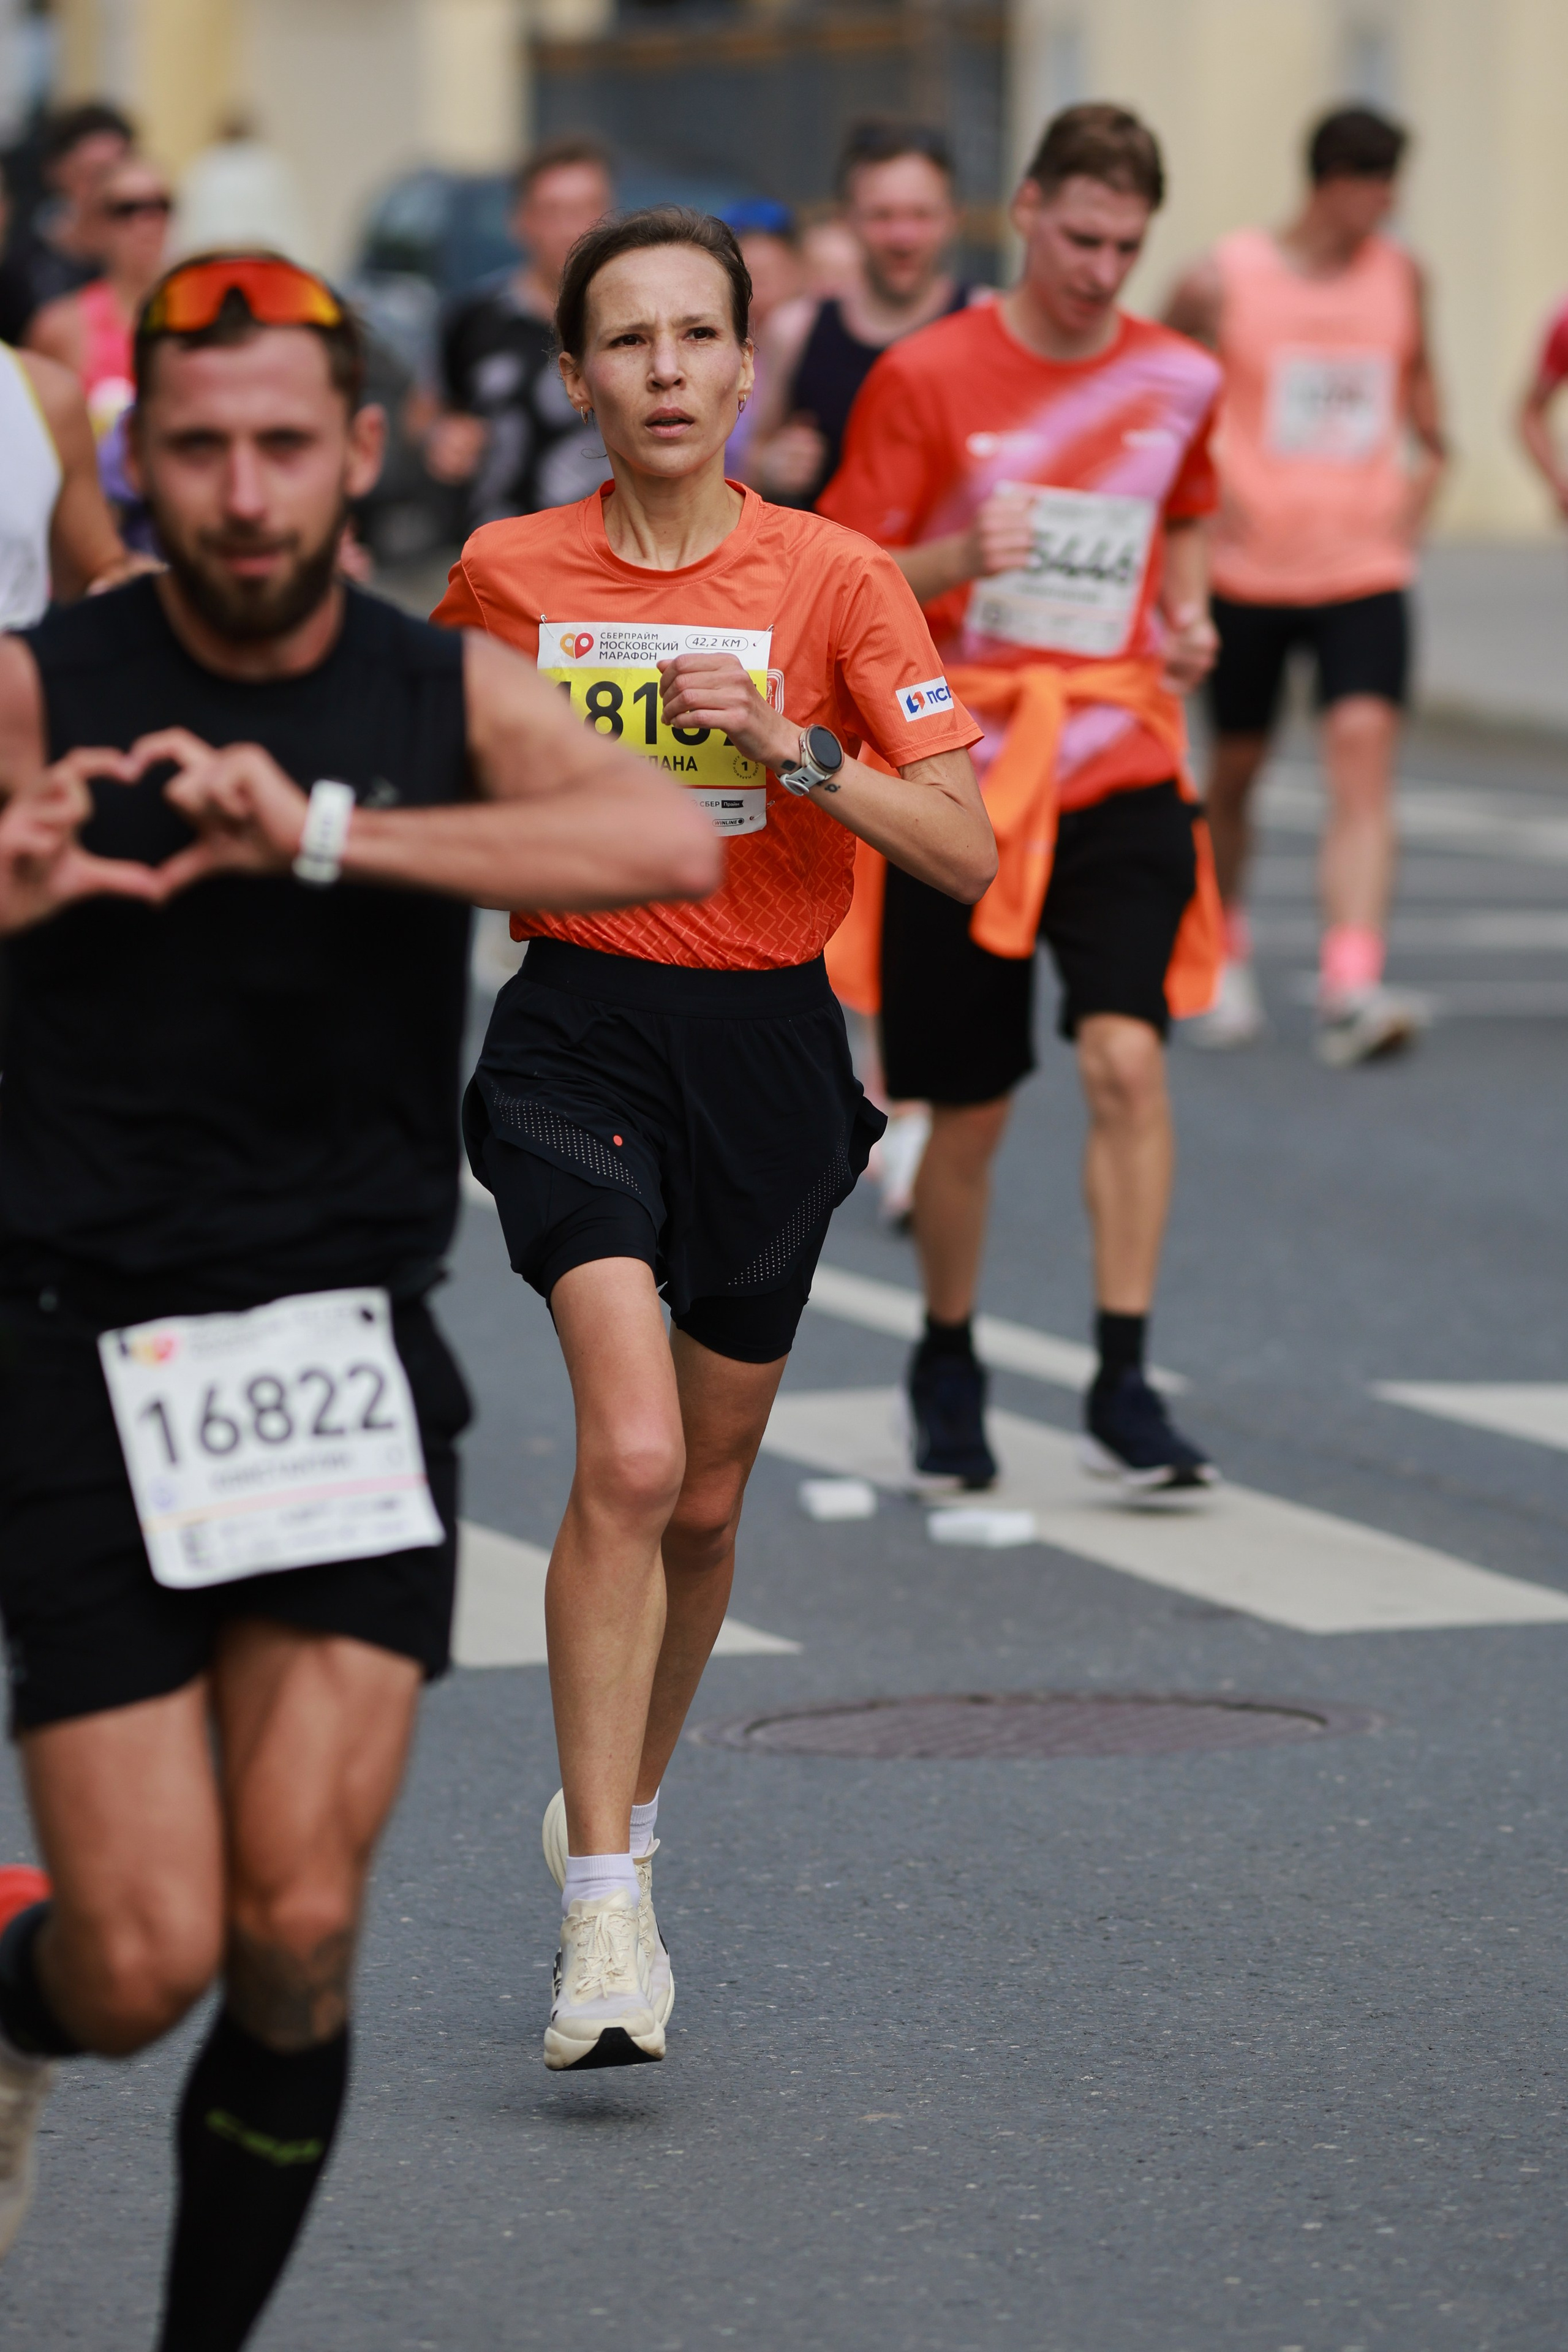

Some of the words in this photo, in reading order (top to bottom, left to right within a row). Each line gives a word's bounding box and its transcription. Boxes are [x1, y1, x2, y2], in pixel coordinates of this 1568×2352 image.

[600, 641, 679, 650] МОСКОВСКИЙ
[692, 637, 717, 647] 42,2
[599, 651, 657, 660] МАРАФОН
[741, 761, 748, 771] 1
[136, 1360, 397, 1466] 16822
